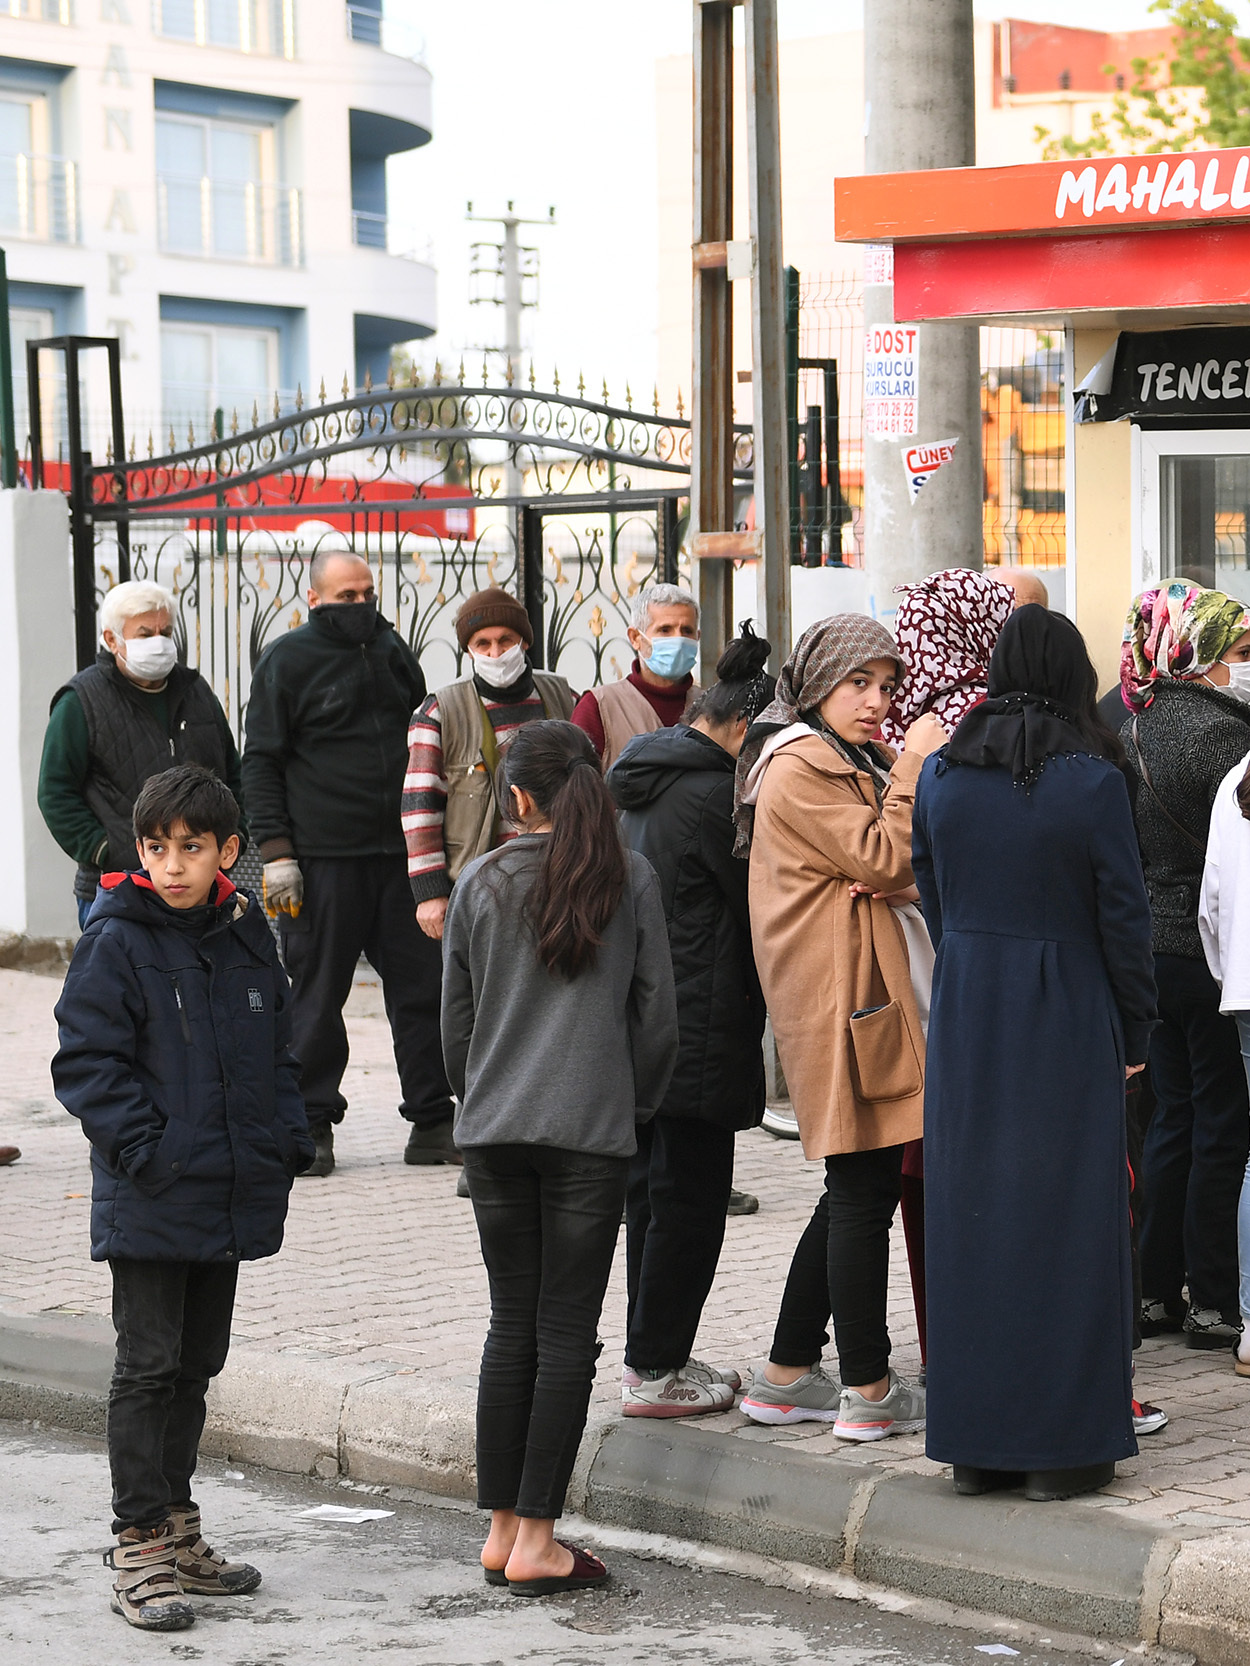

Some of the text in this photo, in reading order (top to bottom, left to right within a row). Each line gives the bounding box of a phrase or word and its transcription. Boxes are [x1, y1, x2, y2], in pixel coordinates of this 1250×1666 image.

[874, 330, 917, 354] DOST
[903, 402, 914, 417] 22
[903, 419, 914, 434] 52
